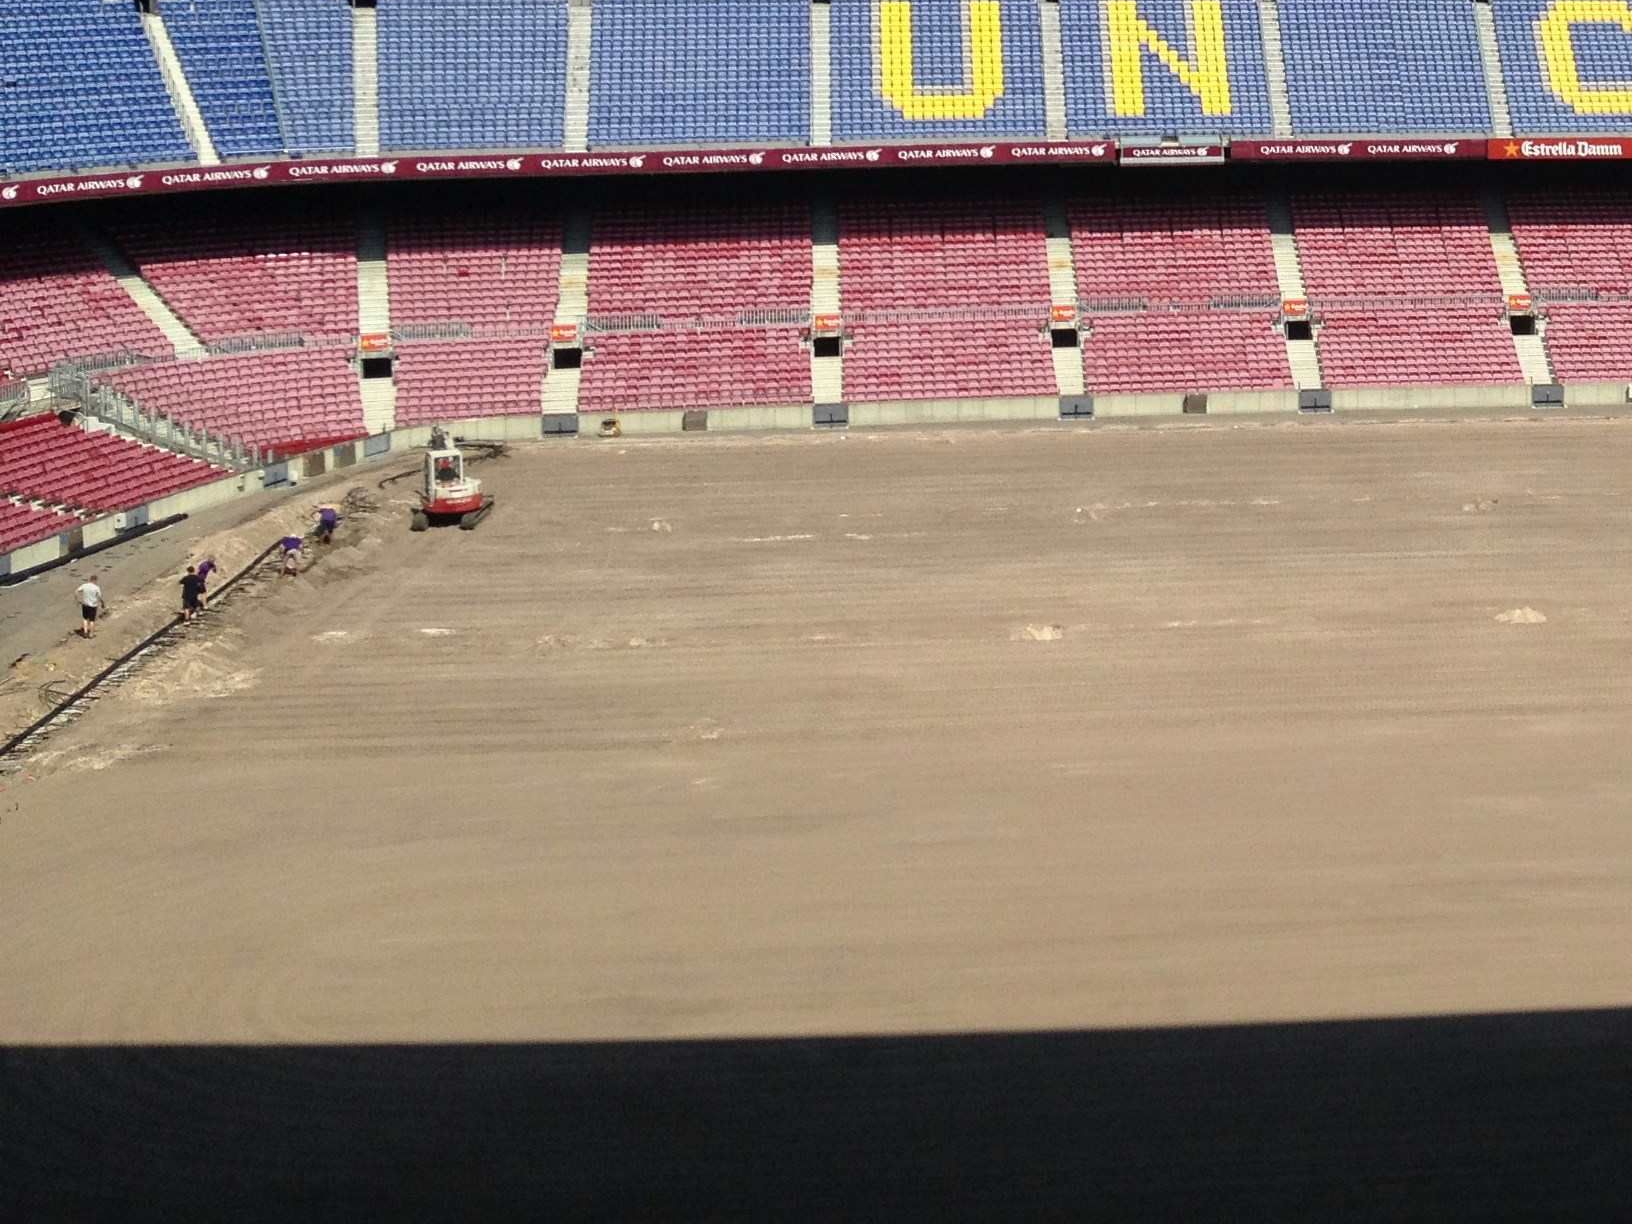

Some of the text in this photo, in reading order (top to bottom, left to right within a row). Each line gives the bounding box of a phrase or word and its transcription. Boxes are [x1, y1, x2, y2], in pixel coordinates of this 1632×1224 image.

[1012, 147, 1090, 157] QATAR AIRWAYS
[1261, 144, 1337, 155] QATAR AIRWAYS
[1368, 144, 1443, 154] QATAR AIRWAYS
[1521, 139, 1623, 156] Estrella Damm
[782, 152, 864, 163] QATAR AIRWAYS
[898, 149, 979, 160] QATAR AIRWAYS
[542, 158, 628, 169] QATAR AIRWAYS
[663, 155, 747, 166] QATAR AIRWAYS
[289, 164, 380, 178] QATAR AIRWAYS
[417, 161, 505, 172] QATAR AIRWAYS
[162, 171, 252, 185] QATAR AIRWAYS
[37, 180, 125, 195] QATAR AIRWAYS
